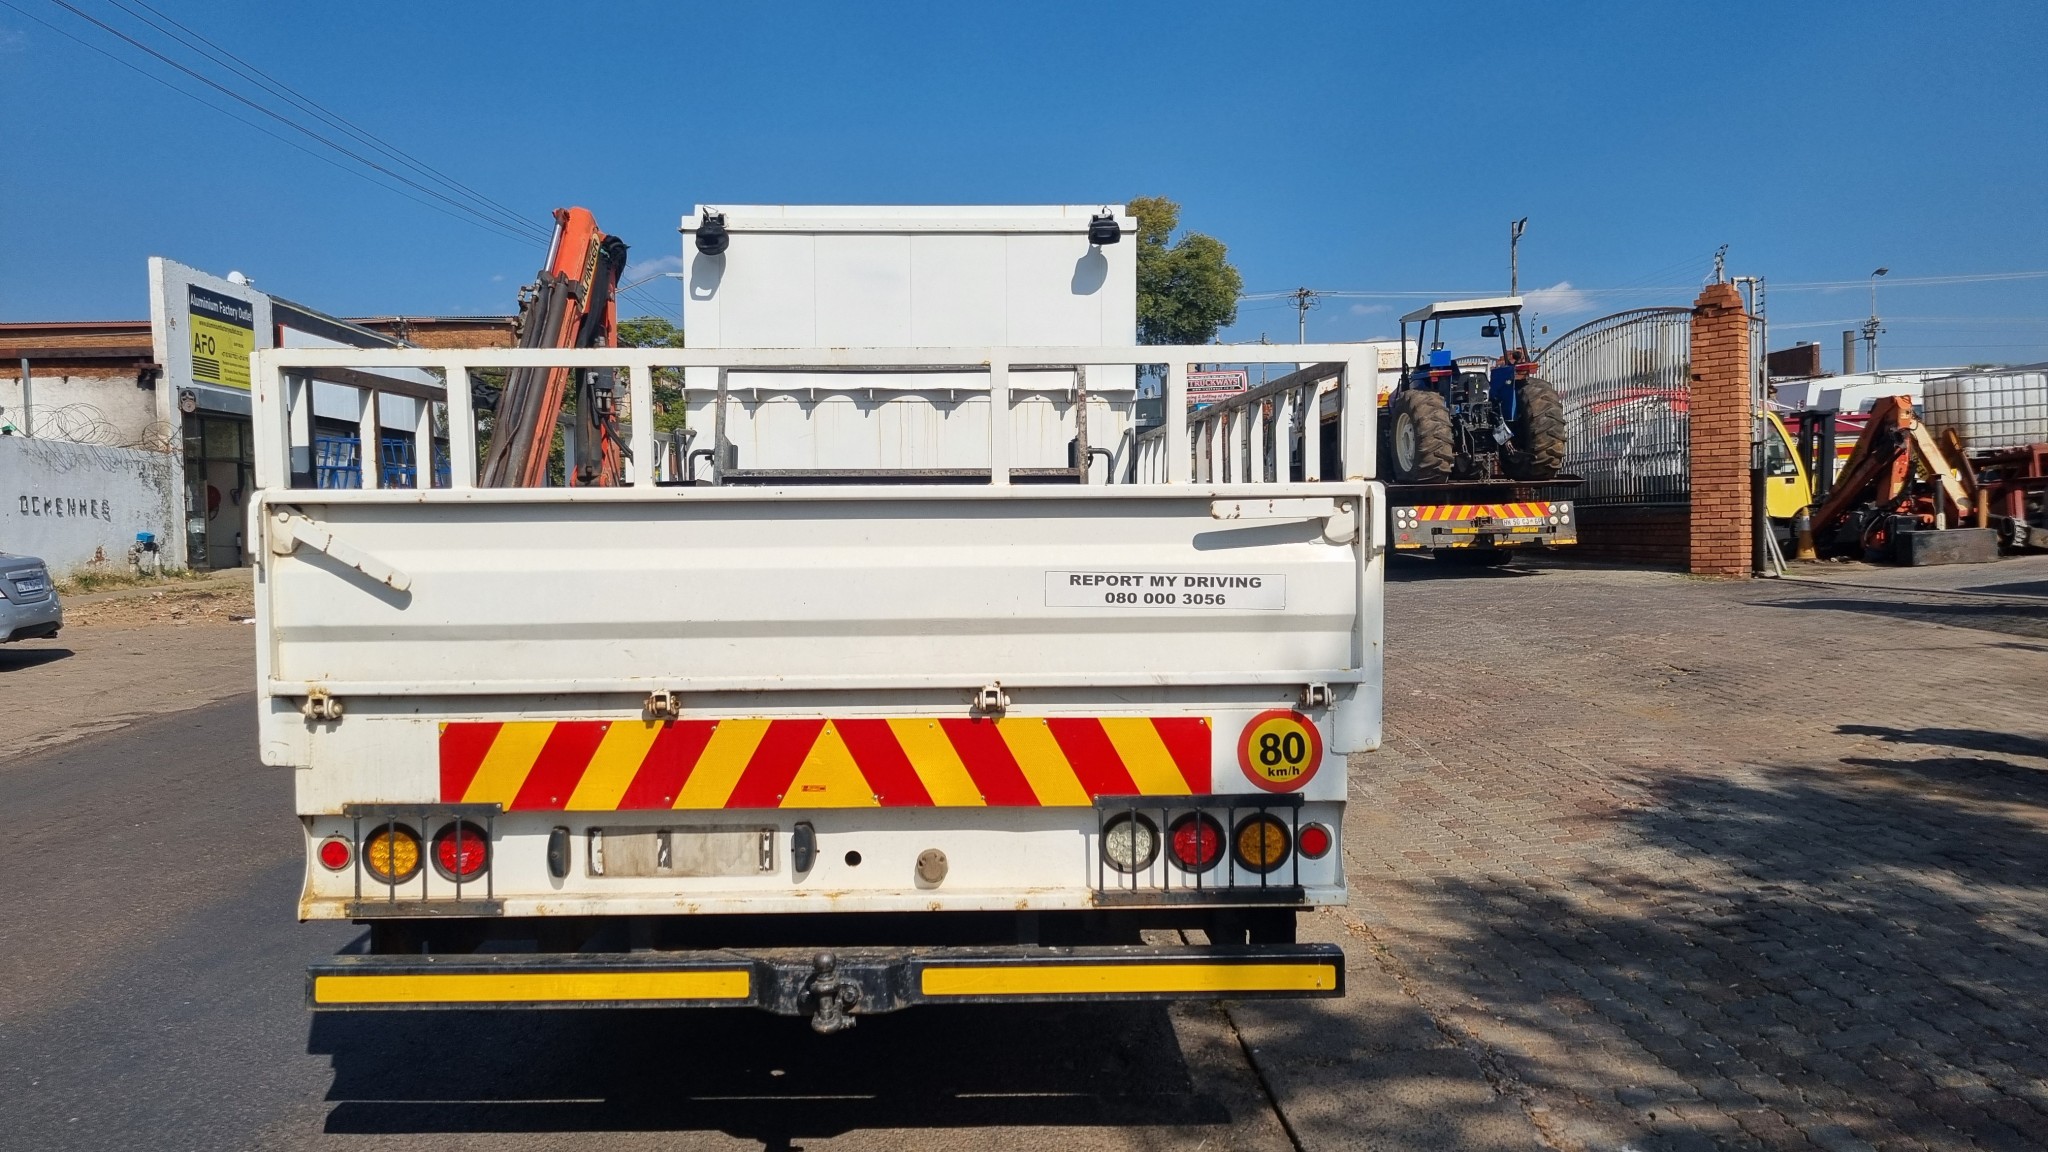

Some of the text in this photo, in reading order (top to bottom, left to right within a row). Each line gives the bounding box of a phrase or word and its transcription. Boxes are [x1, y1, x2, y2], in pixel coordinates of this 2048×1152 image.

[580, 238, 600, 309] ALFINGER
[190, 293, 252, 322] Aluminium Factory Outlet
[194, 332, 215, 355] AFO
[1189, 378, 1238, 387] TRUCKWAYS
[1069, 574, 1262, 588] REPORT MY DRIVING
[1105, 592, 1226, 605] 080 000 3056
[1260, 731, 1306, 766] 80
[1267, 766, 1300, 777] km/h
